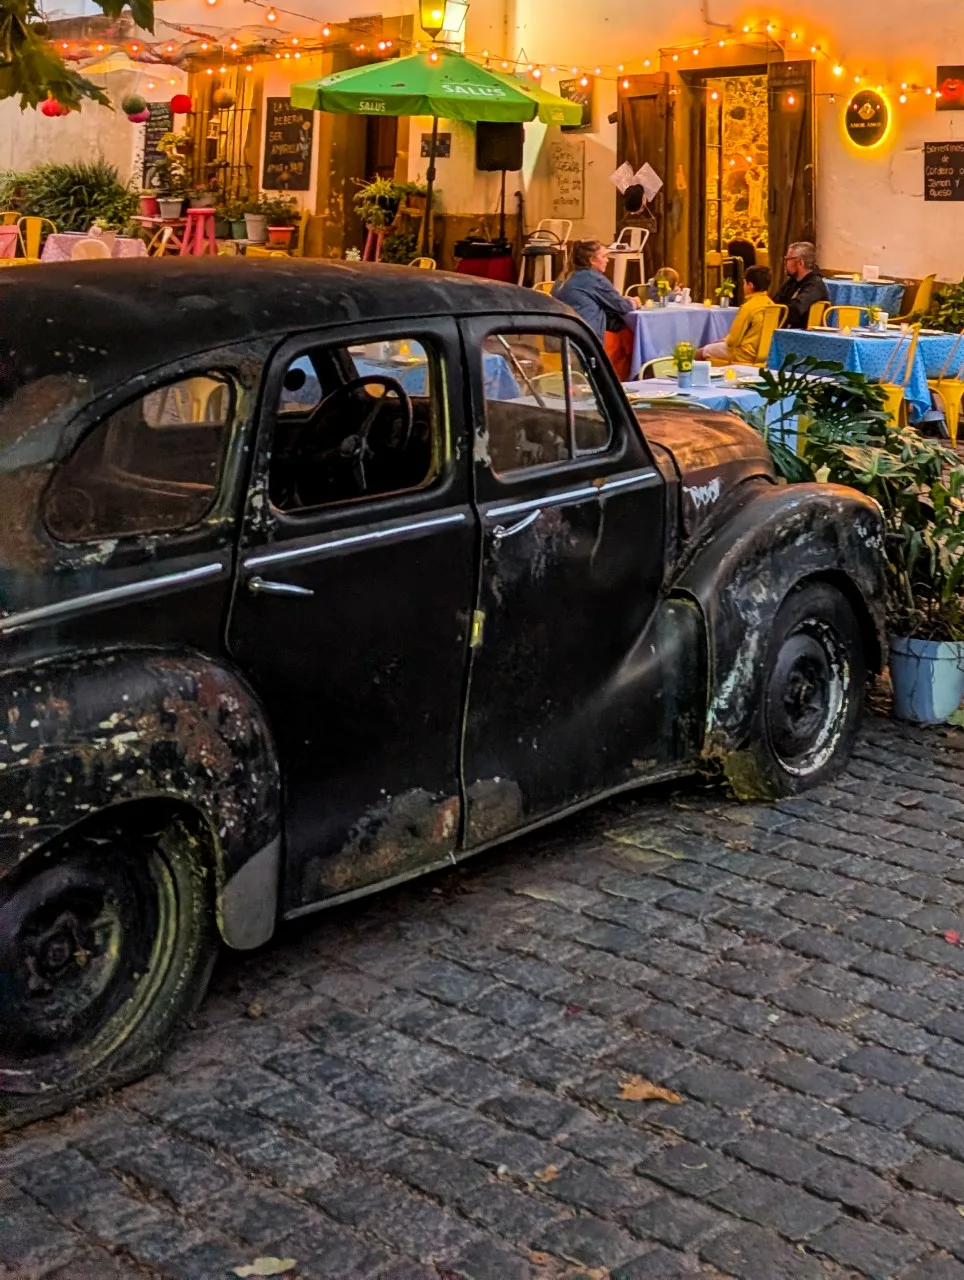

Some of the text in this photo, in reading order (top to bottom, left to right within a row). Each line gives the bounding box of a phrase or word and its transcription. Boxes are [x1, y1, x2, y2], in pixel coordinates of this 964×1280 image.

[441, 84, 506, 97] SALUS
[358, 100, 386, 112] SALUS
[941, 154, 950, 162] de
